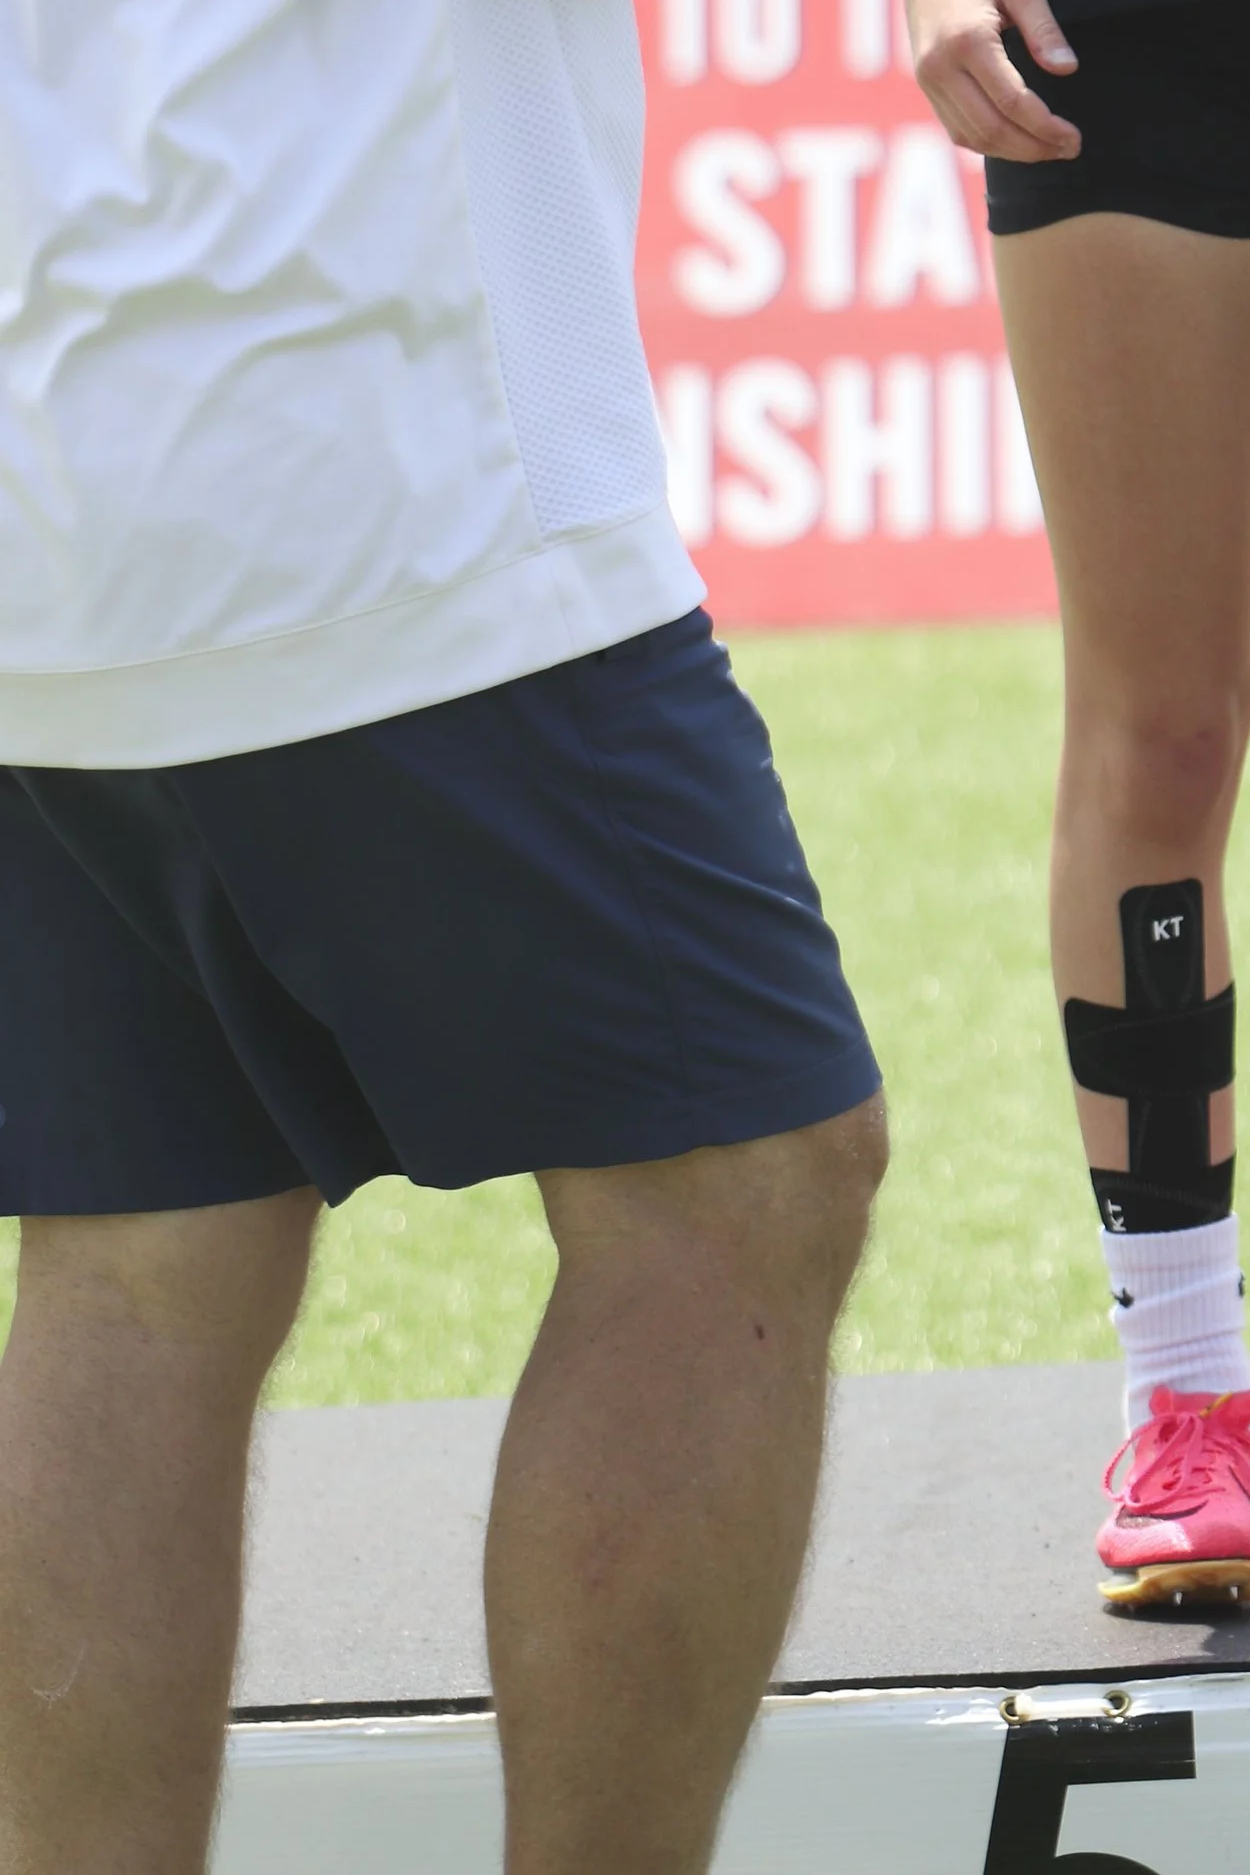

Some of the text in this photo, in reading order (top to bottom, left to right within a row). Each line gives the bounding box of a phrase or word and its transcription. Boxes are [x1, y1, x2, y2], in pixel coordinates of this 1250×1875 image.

[672, 128, 998, 315] STA
[1153, 915, 1184, 941] KT
[1107, 1198, 1127, 1232] KT
